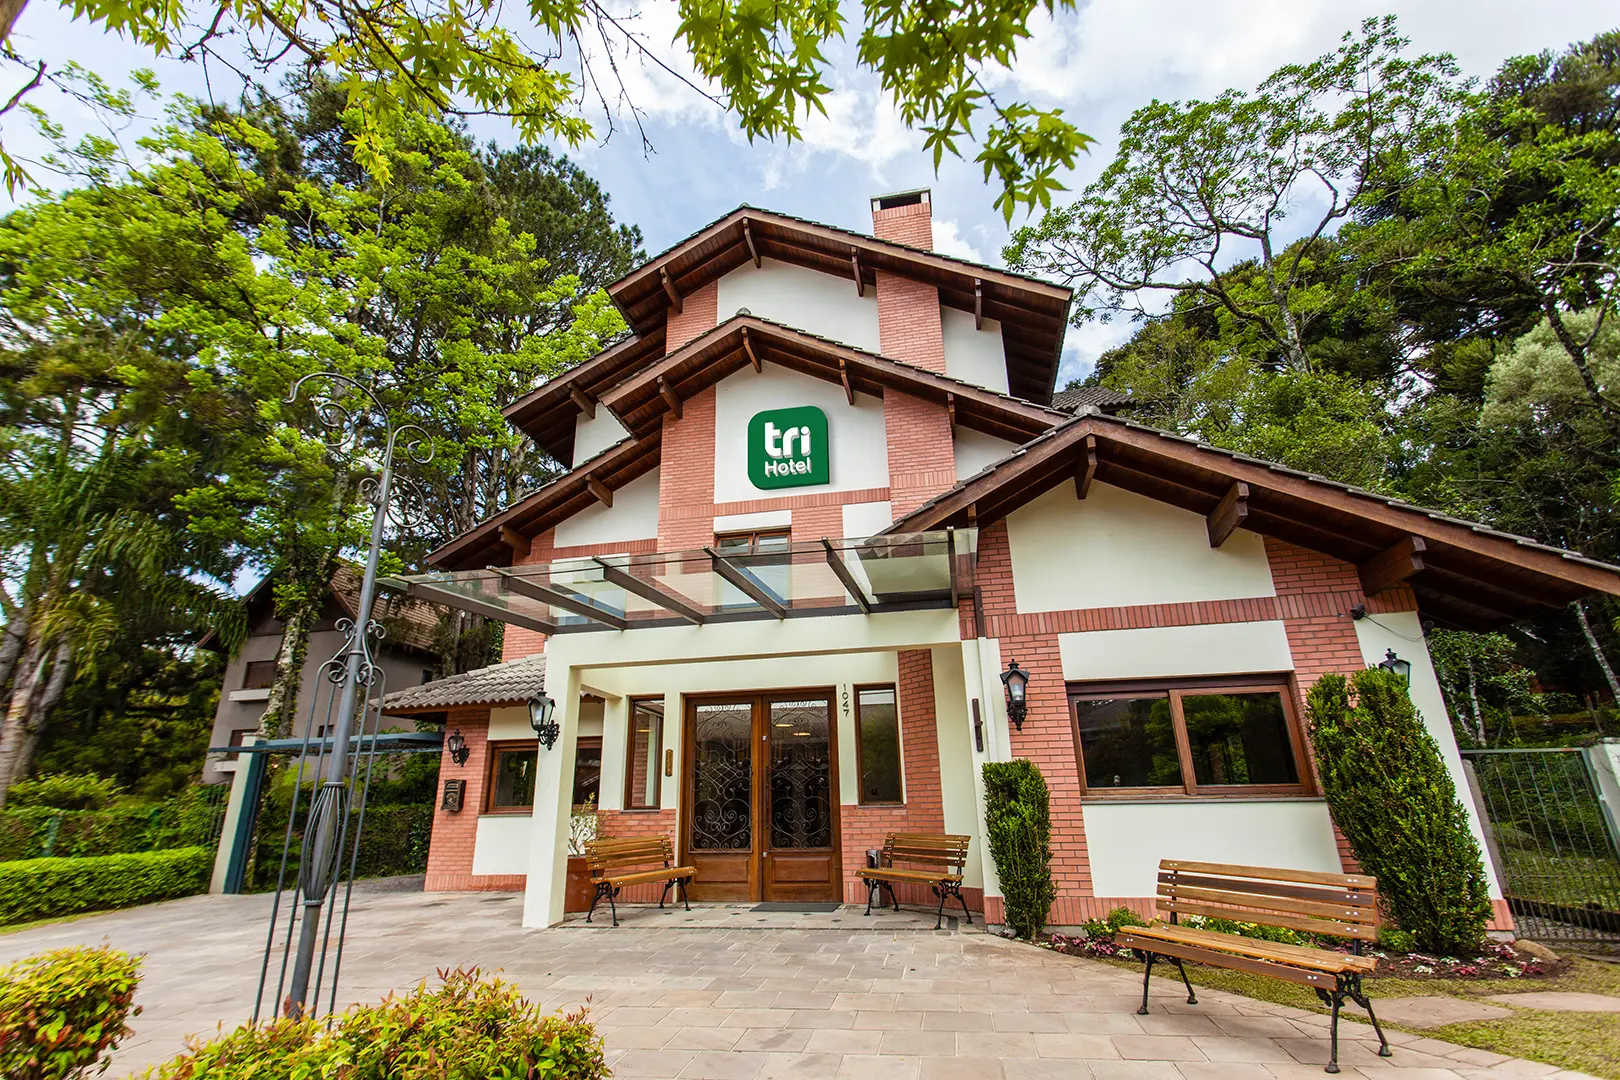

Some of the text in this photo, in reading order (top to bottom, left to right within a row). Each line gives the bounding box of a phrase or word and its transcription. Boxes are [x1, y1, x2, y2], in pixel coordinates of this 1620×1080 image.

[764, 421, 812, 459] tri
[764, 456, 812, 478] Hotel
[842, 683, 850, 718] 1047
